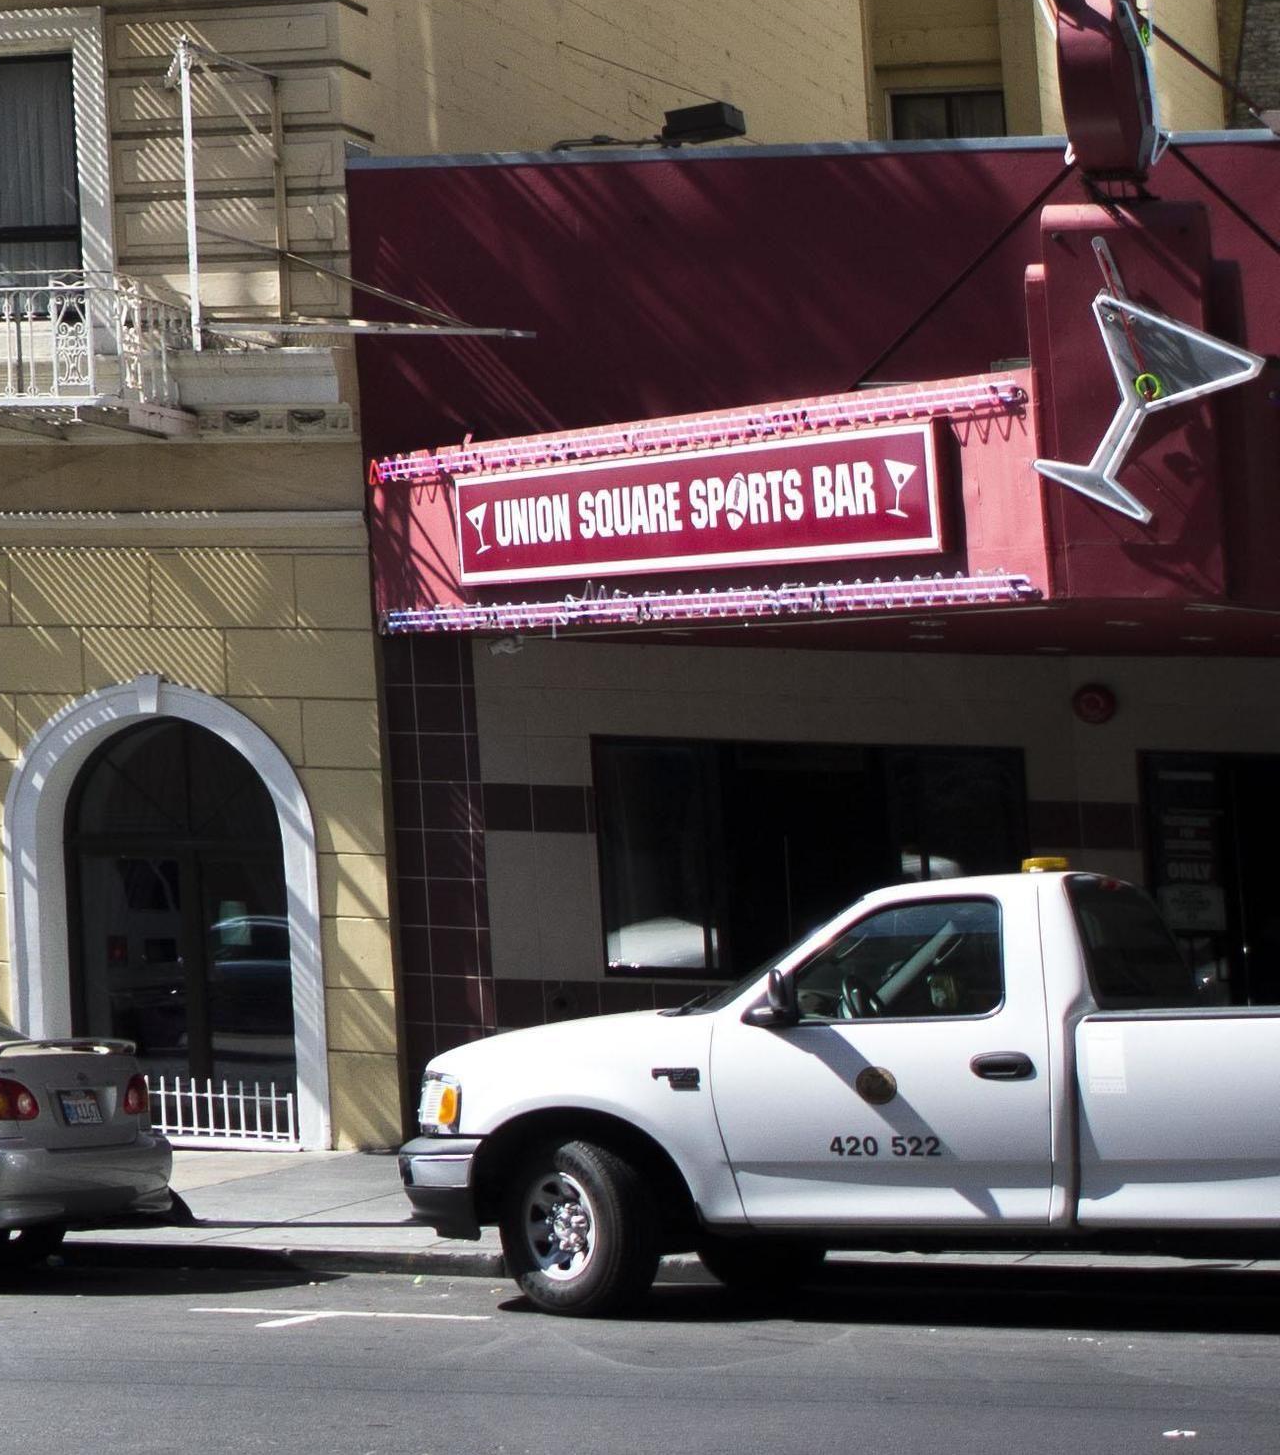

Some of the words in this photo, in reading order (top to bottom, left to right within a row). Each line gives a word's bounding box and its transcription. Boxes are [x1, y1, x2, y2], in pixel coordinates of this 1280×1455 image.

[494, 493, 572, 547] UNION
[578, 481, 683, 539] SQUARE
[689, 468, 804, 531] SPORTS
[812, 461, 876, 519] BAR
[1167, 862, 1211, 879] ONLY
[829, 1136, 879, 1156] 420
[892, 1136, 941, 1156] 522
